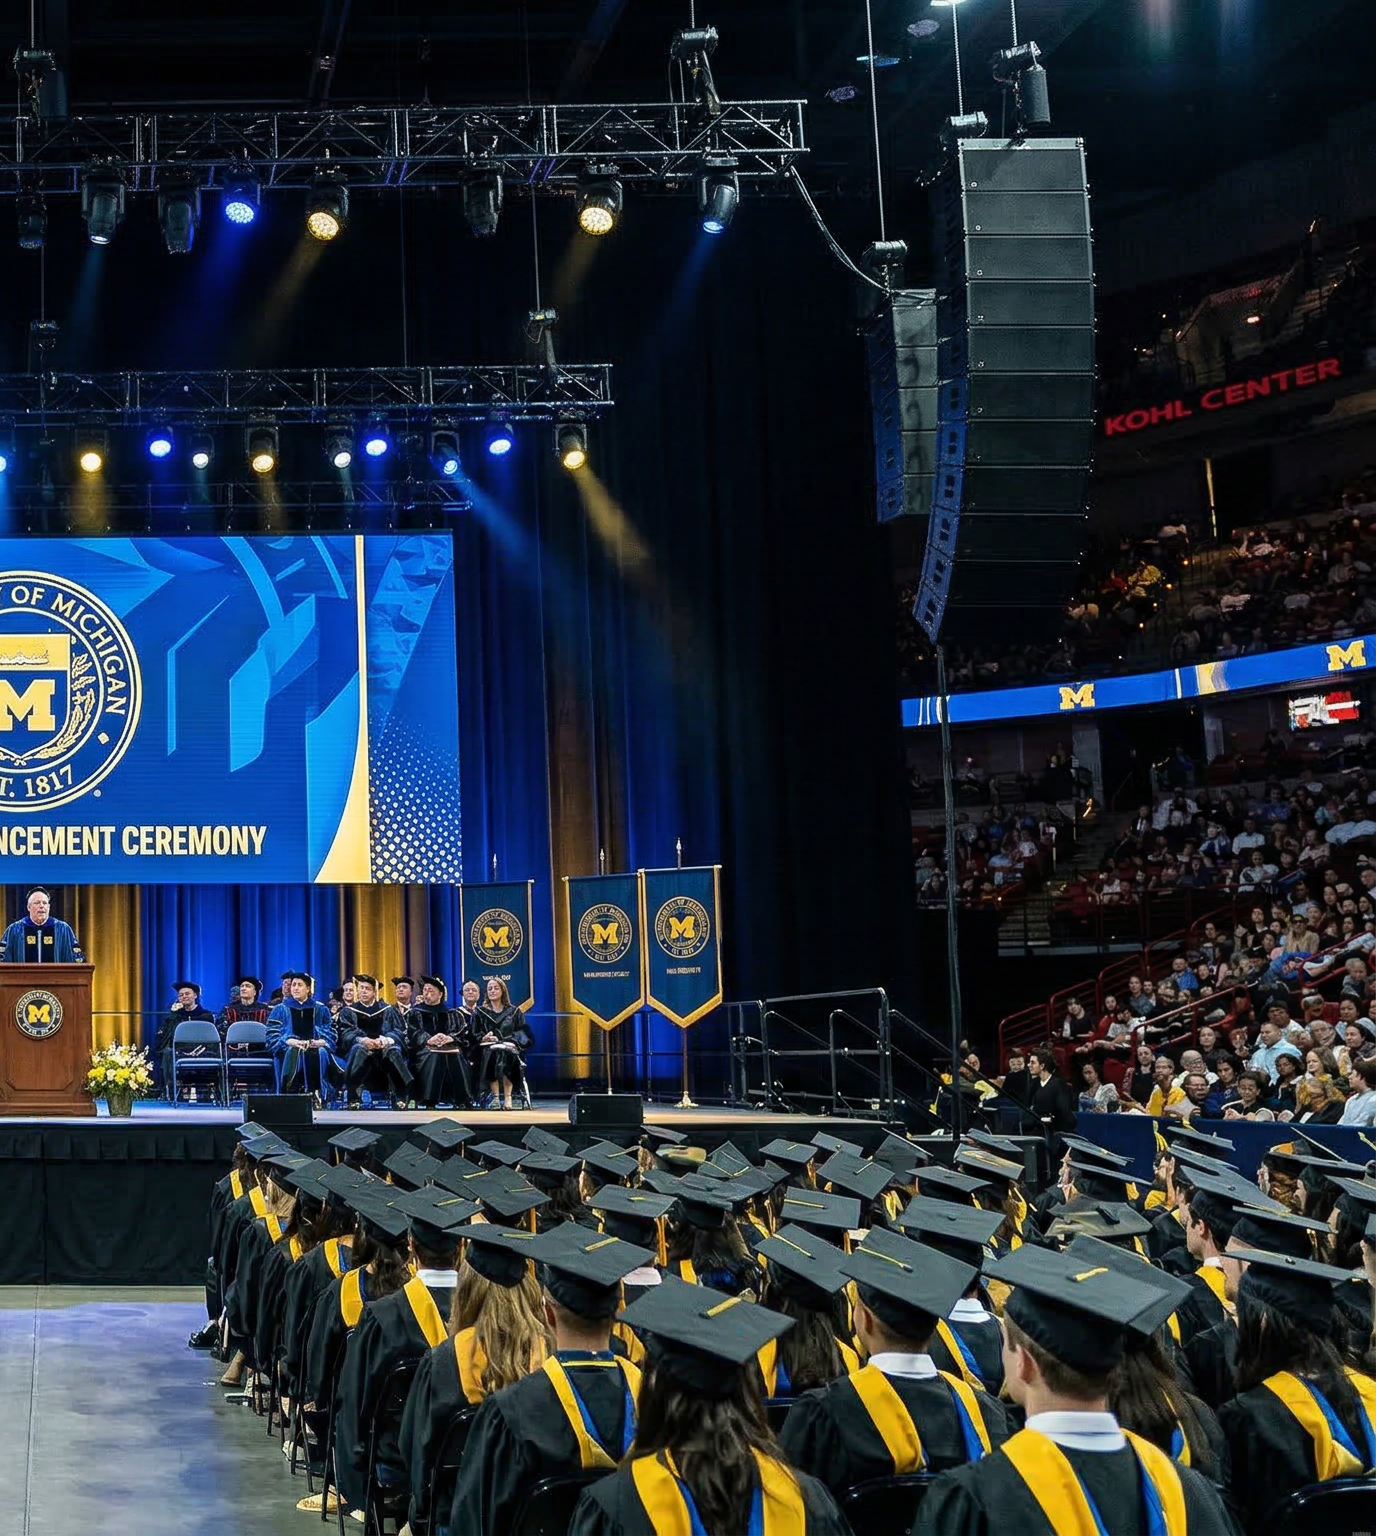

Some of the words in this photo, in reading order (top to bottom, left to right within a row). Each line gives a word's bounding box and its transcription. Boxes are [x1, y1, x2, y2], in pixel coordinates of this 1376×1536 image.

[1105, 400, 1193, 436] KOHL
[1201, 358, 1341, 409] CENTER
[11, 585, 45, 606] OF
[51, 592, 126, 715] MICHIGAN
[1327, 640, 1367, 671] M
[1060, 683, 1095, 710] M
[24, 764, 73, 797] 1817
[122, 826, 267, 856] CEREMONY
[483, 926, 510, 948] M
[591, 922, 619, 945] M
[668, 915, 696, 940] M
[27, 1004, 51, 1024] M
